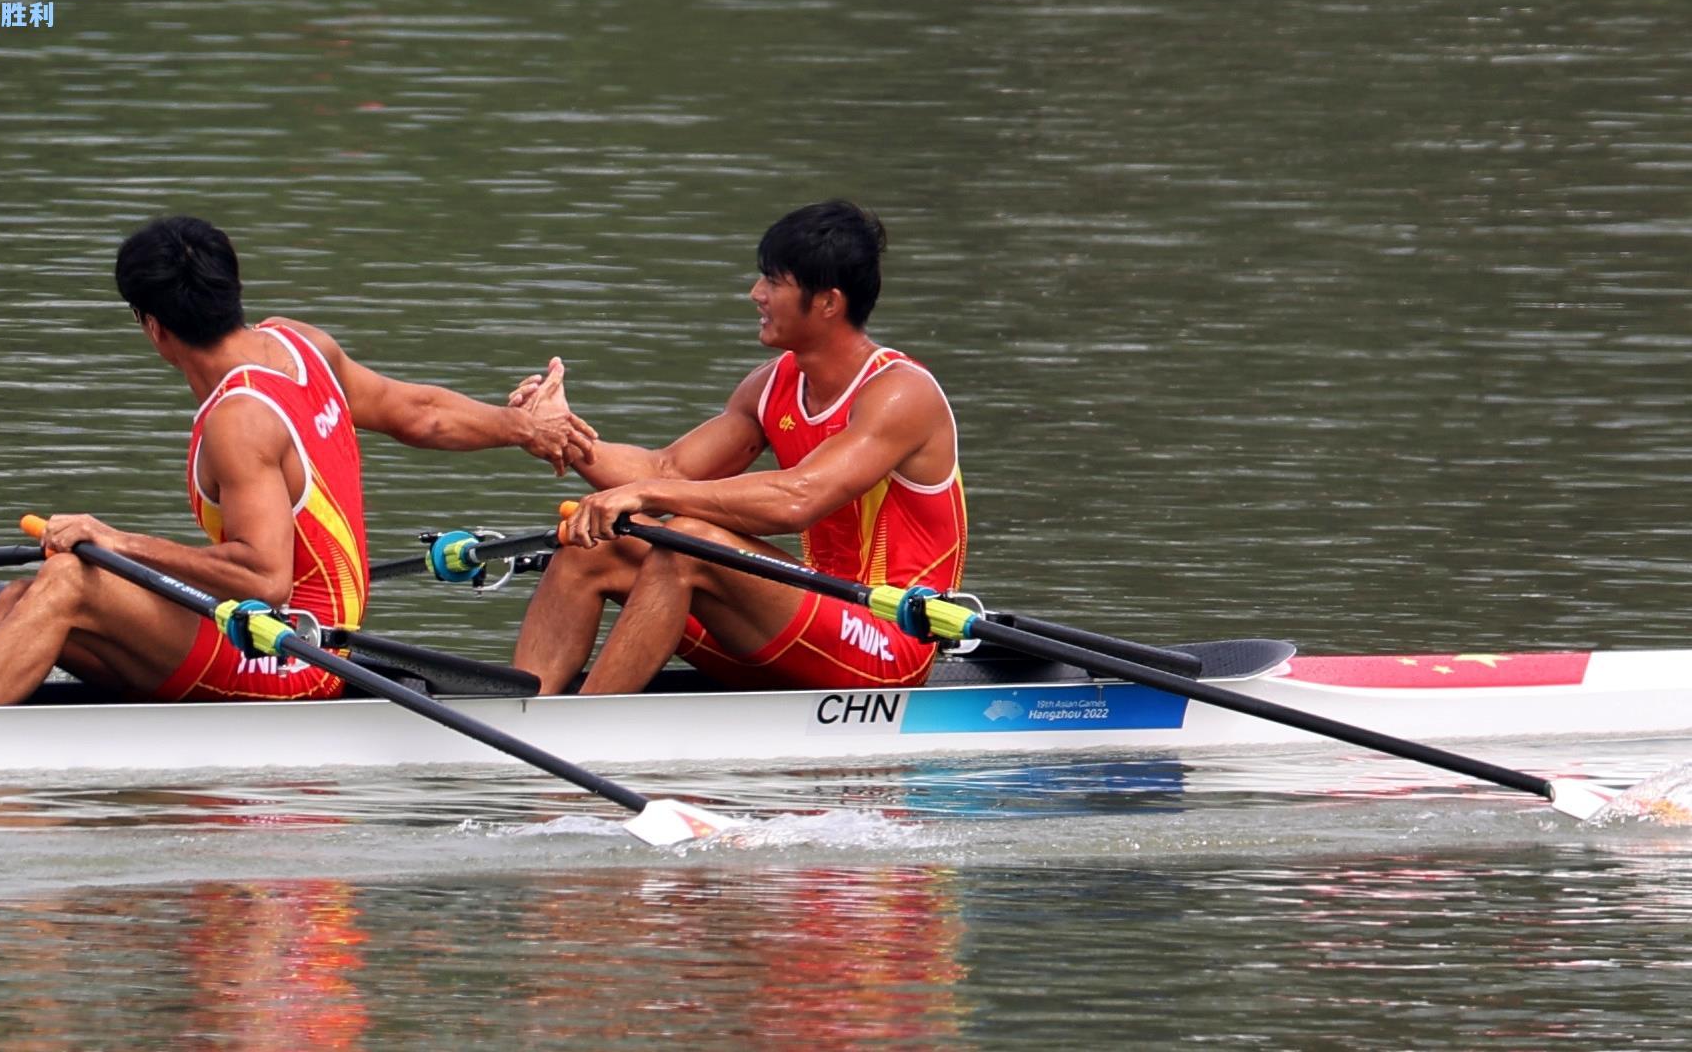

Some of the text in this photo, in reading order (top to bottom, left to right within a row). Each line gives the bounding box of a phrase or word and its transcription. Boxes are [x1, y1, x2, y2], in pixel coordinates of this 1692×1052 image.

[817, 693, 901, 724] CHN
[1036, 699, 1107, 709] 19th Asian Games
[1028, 708, 1110, 721] Hangzhou 2022
